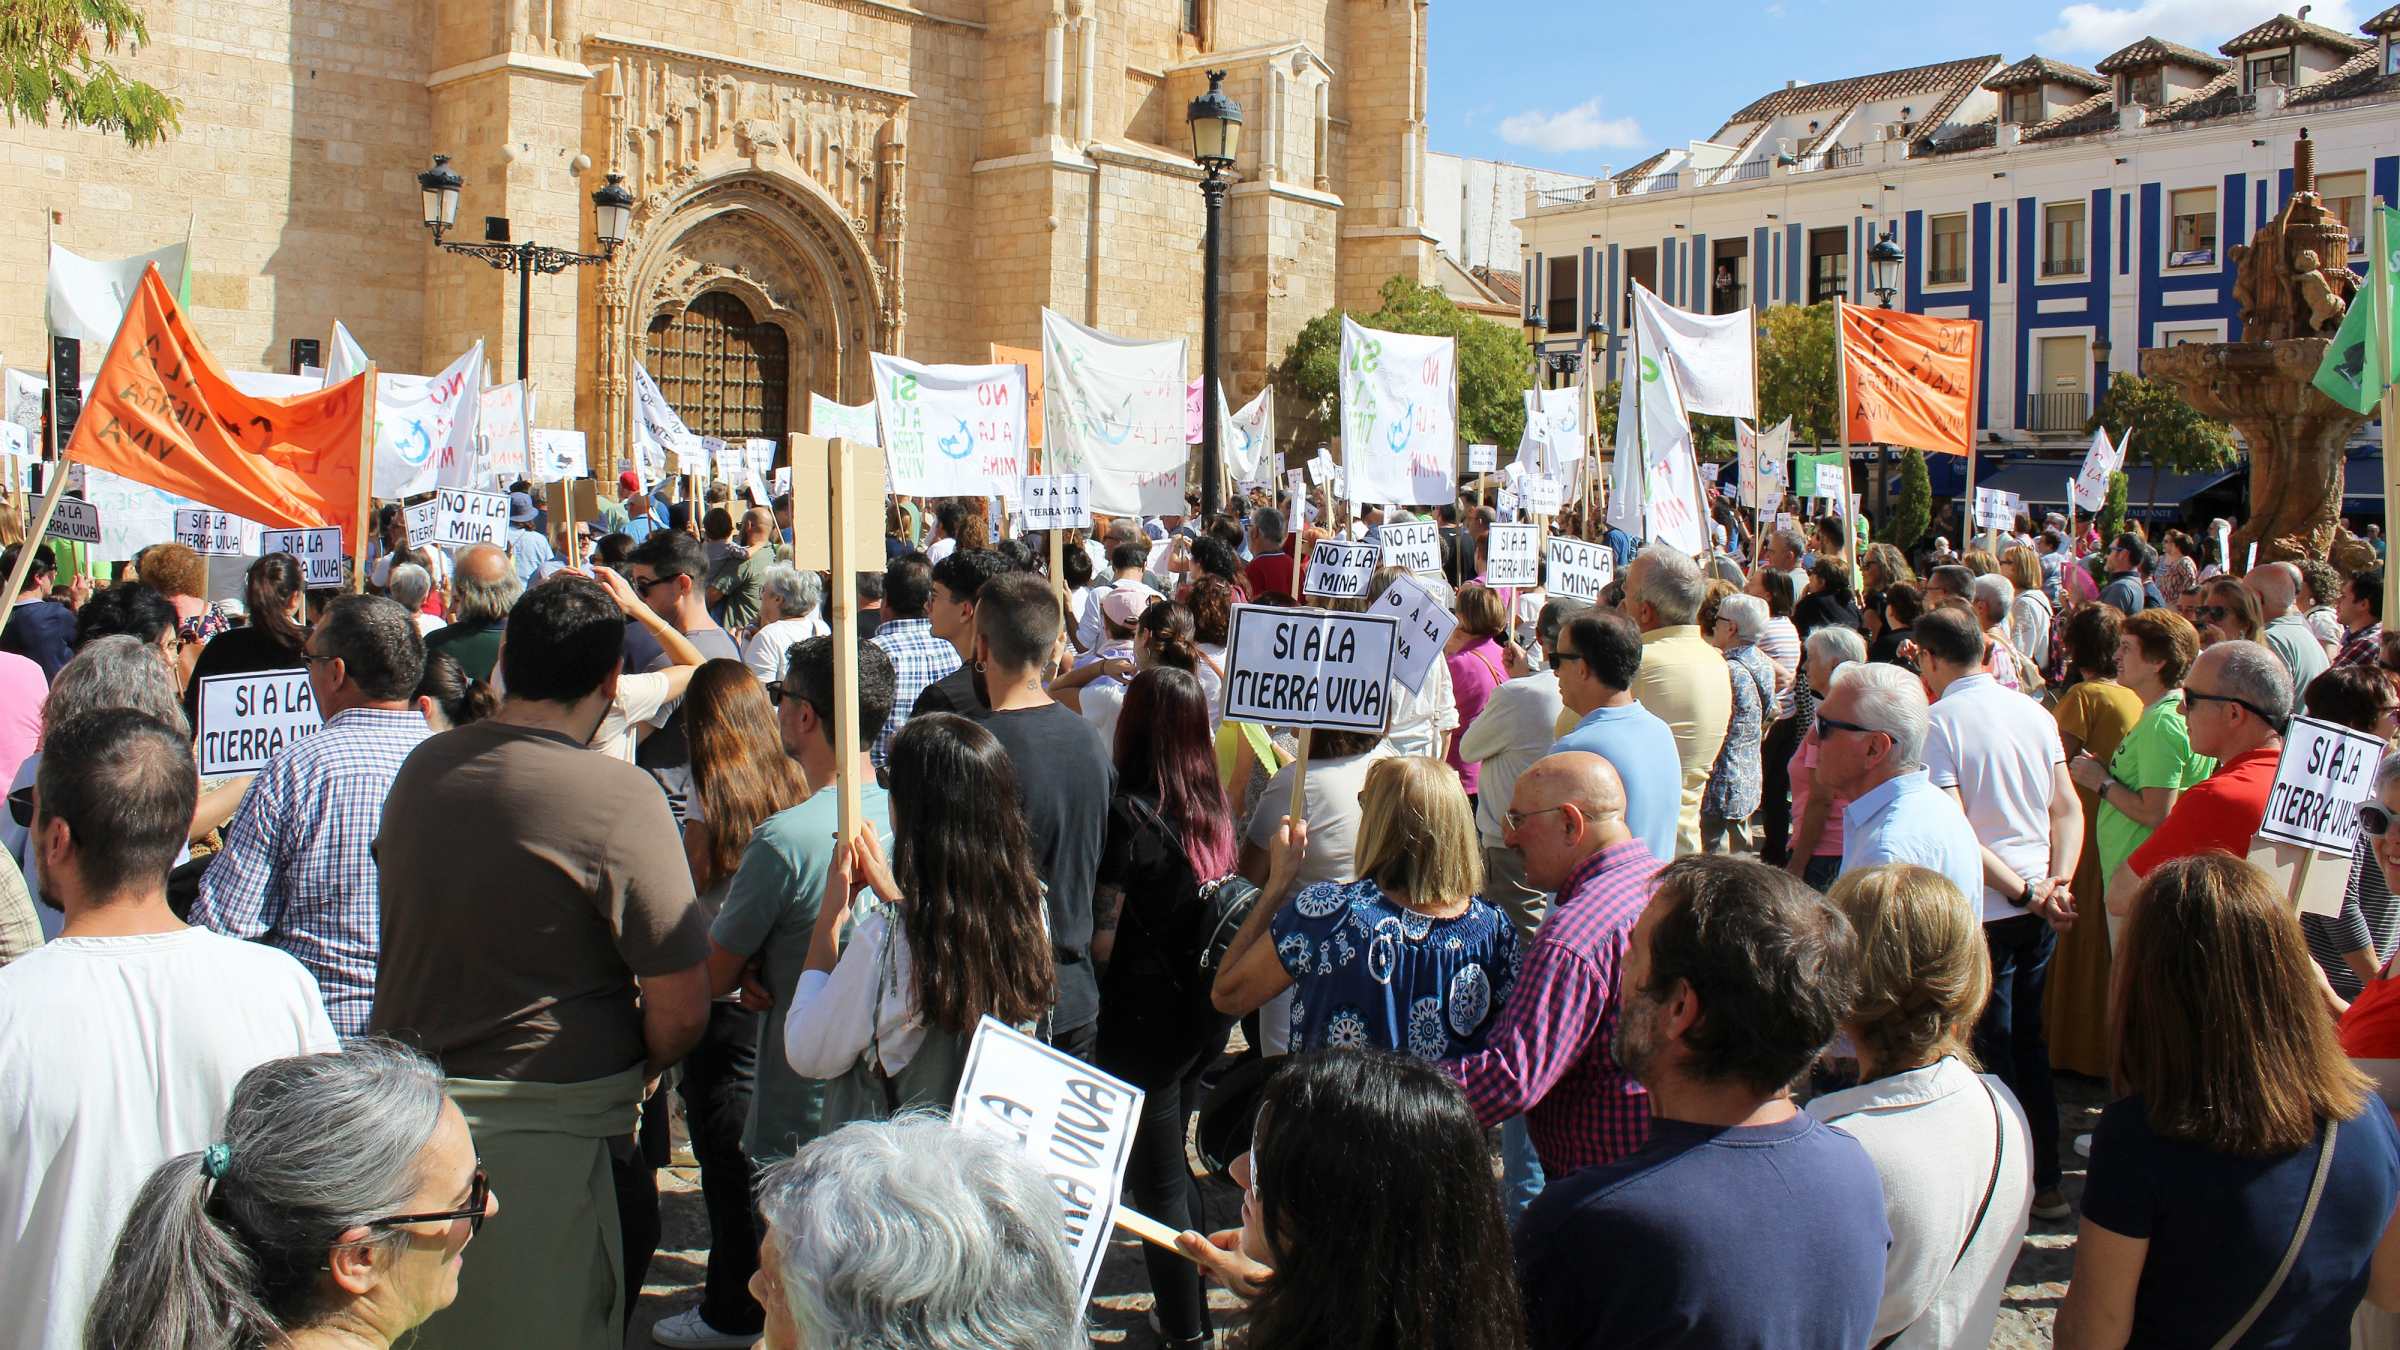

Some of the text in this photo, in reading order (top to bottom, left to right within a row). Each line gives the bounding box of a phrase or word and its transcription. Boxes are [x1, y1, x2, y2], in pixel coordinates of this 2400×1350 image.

[1033, 487, 1079, 496] SI A LA
[59, 506, 82, 519] A LA
[419, 508, 428, 523] SI
[441, 492, 506, 518] NO A LA
[1029, 506, 1083, 516] TIERRA VIVA
[73, 523, 97, 538] VIVA
[192, 514, 227, 529] SI A LA
[450, 520, 492, 542] MINA
[178, 533, 239, 550] TIERRA VIVA
[283, 535, 323, 552] SI A LA
[409, 525, 433, 542] TIER
[1383, 526, 1436, 547] NO A LA
[1501, 532, 1527, 551] SI A A
[1314, 546, 1374, 568] NO A LA
[1396, 552, 1430, 569] MINA
[1552, 543, 1609, 572] NO A LA
[313, 559, 339, 577] VIVA
[1491, 559, 1517, 579] TIERRA
[1319, 573, 1358, 592] MINA
[1562, 572, 1600, 595] MINA
[1386, 590, 1439, 643] NO A LA
[1273, 623, 1355, 663] SI A LA
[1399, 637, 1411, 660] NA
[235, 681, 312, 717] SI A LA
[1235, 670, 1381, 716] TIERRA VIVA
[206, 727, 283, 764] TIERRA
[2307, 736, 2362, 785] SI A LA
[2271, 782, 2360, 840] TIERRA VIVA
[1050, 1079, 1117, 1169] VIVA
